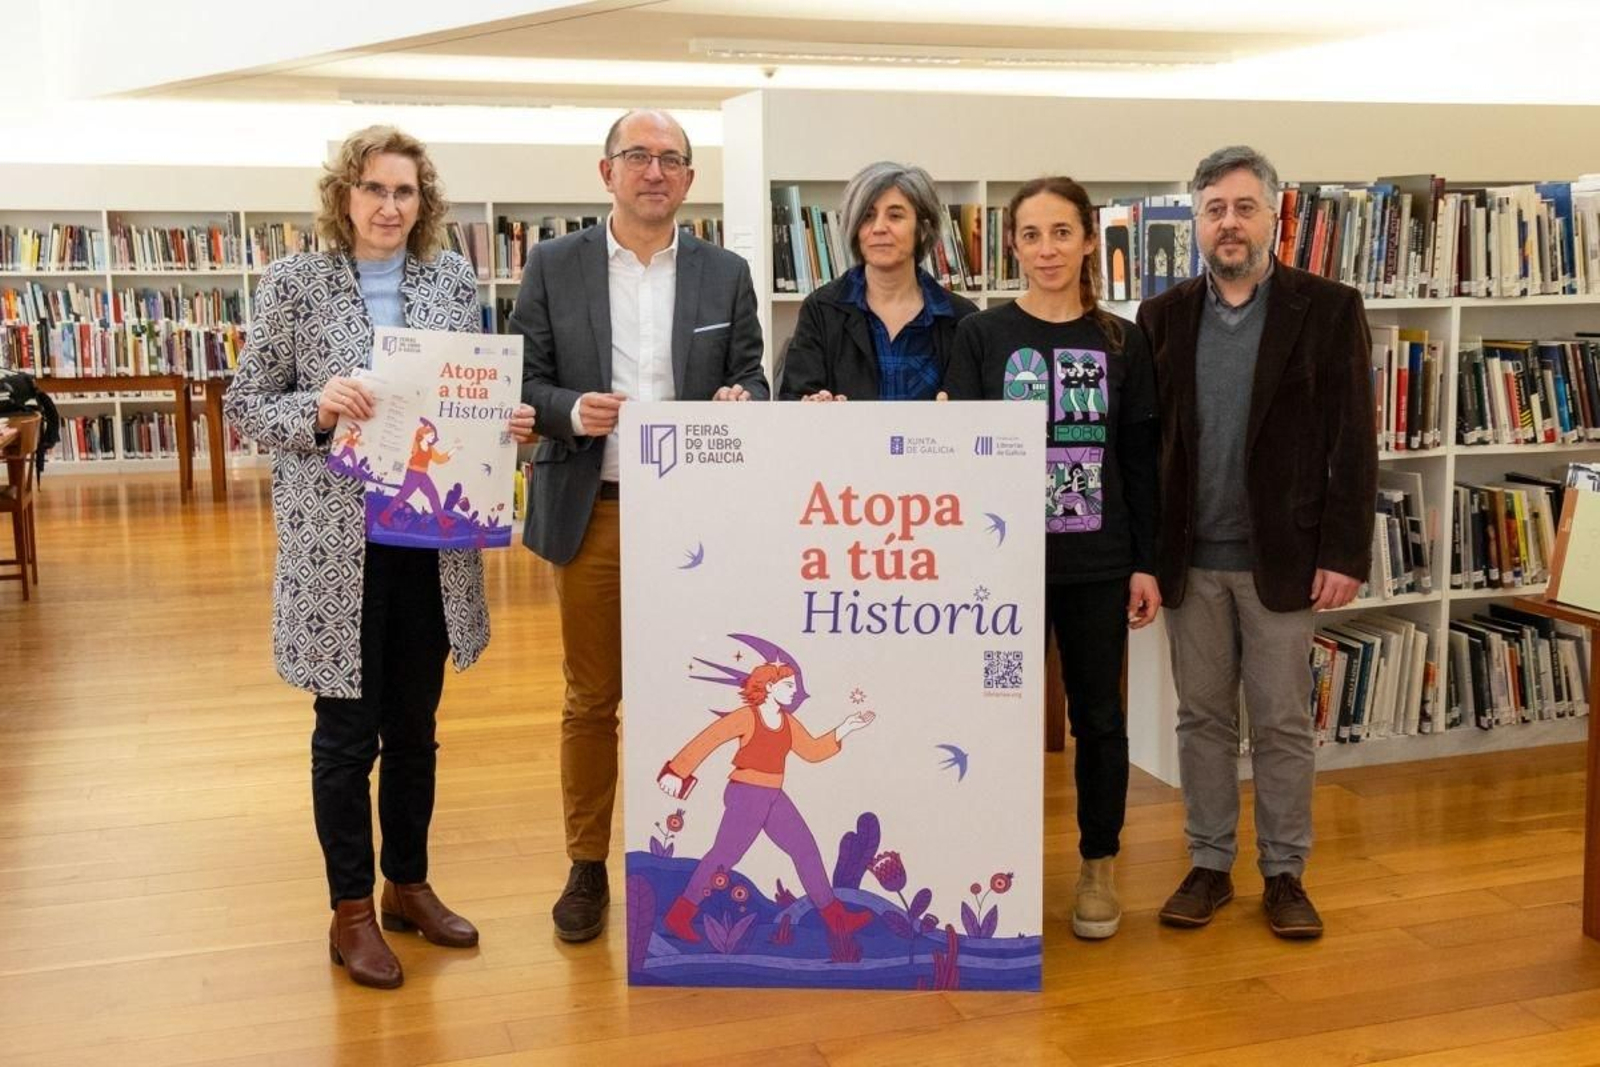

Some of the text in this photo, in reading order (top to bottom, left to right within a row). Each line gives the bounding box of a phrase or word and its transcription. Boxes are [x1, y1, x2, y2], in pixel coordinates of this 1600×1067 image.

[440, 362, 498, 385] Atopa
[439, 381, 489, 399] a túa
[439, 401, 514, 419] Historia
[685, 424, 729, 436] FEIRAS
[685, 438, 742, 450] DO LIBRO
[698, 452, 745, 463] GALICIA
[799, 481, 964, 541] Atopa
[800, 532, 939, 580] a túa
[802, 585, 1023, 636] Historia
